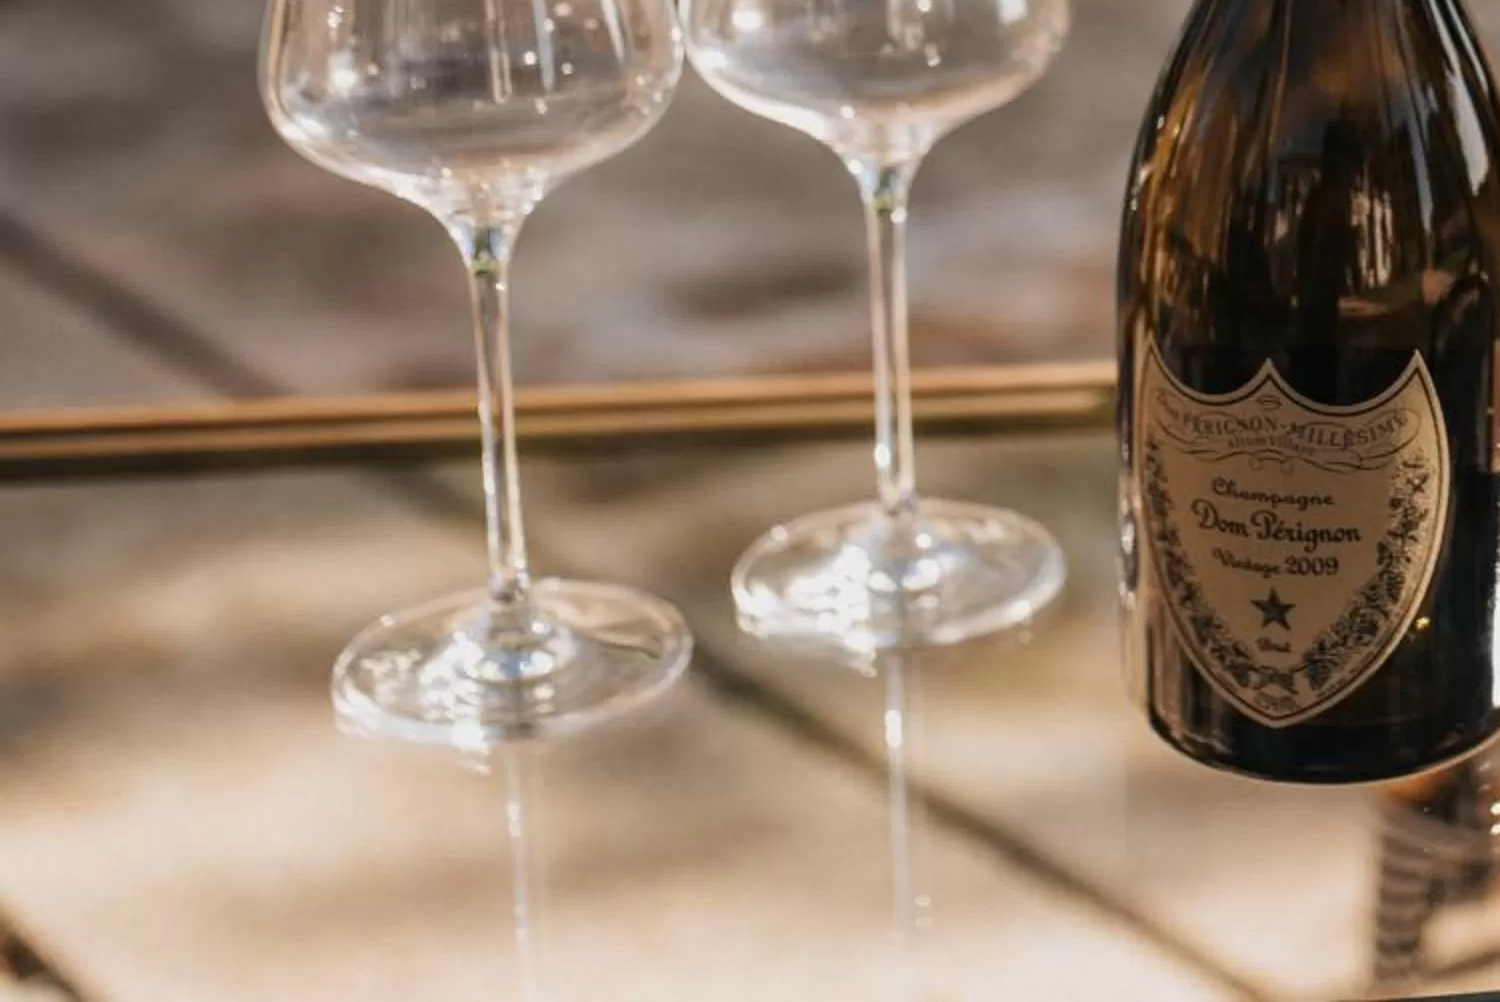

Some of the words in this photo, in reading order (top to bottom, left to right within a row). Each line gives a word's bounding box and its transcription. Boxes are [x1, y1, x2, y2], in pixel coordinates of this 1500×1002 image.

[1212, 477, 1335, 510] Champagne
[1191, 498, 1249, 537] Dom
[1250, 510, 1361, 553] Pérignon
[1212, 548, 1280, 578] Vintage
[1284, 556, 1339, 576] 2009
